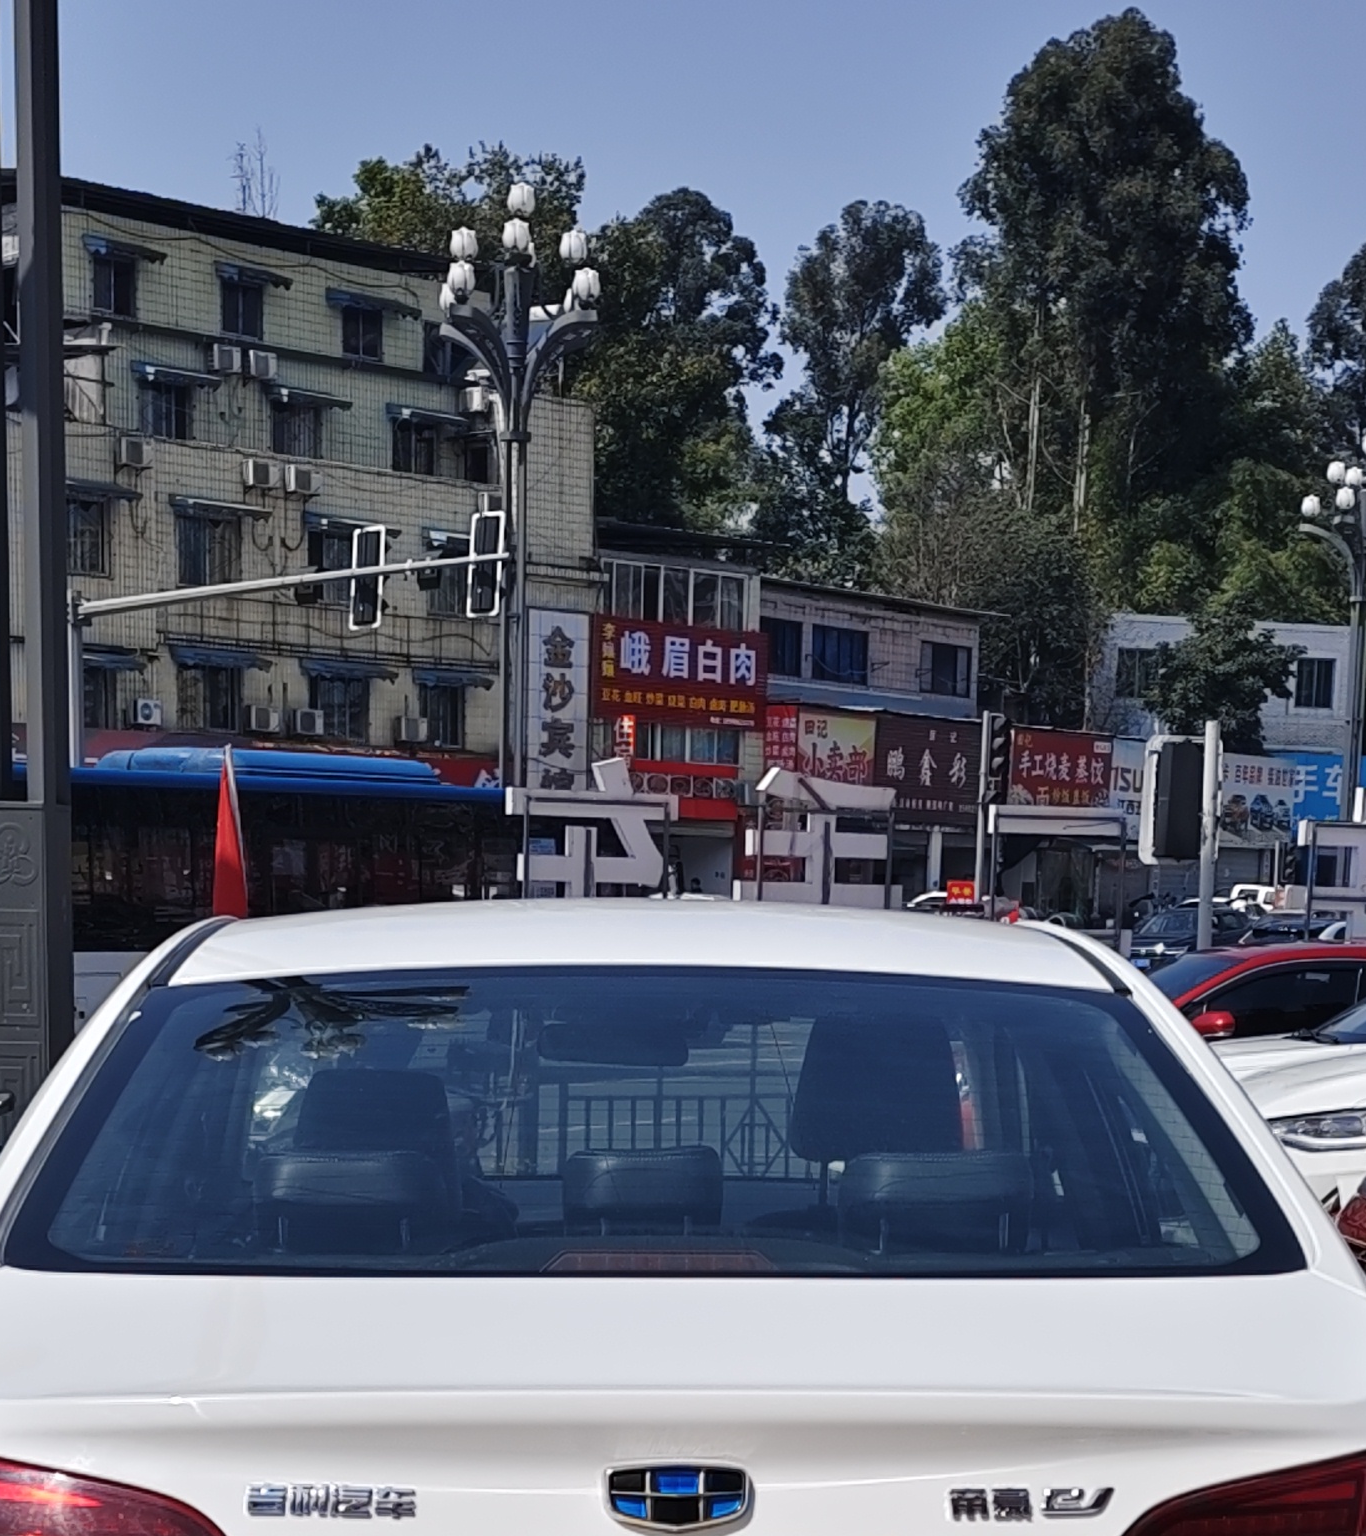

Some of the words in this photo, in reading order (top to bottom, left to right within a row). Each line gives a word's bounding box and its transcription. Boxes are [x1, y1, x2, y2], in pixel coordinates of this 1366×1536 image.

[620, 630, 756, 686] 峨眉白肉
[244, 1482, 417, 1521] 吉利汽车
